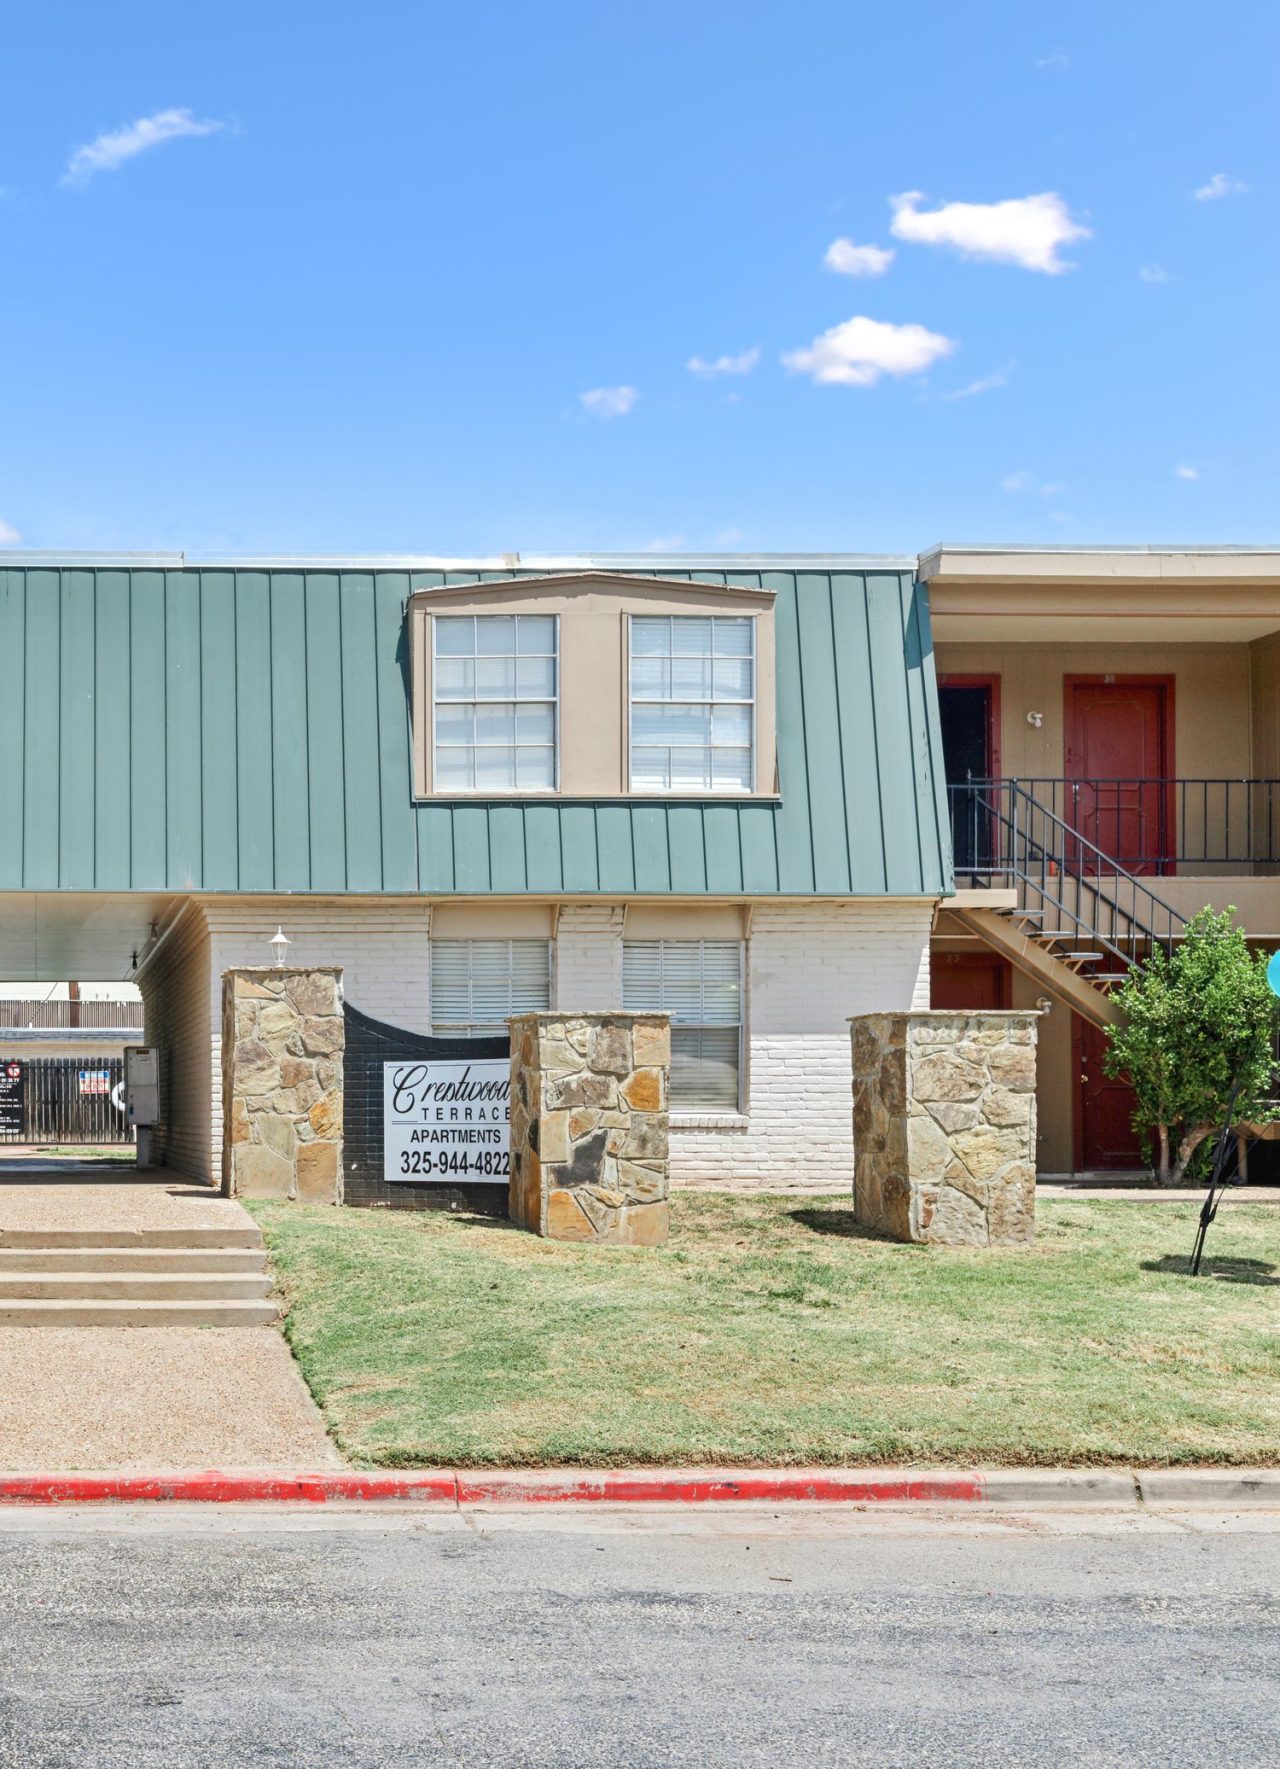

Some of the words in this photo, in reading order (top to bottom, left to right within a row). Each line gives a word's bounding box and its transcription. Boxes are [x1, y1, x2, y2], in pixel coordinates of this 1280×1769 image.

[422, 1107, 510, 1121] TERRACE
[410, 1129, 501, 1144] APARTMENTS
[400, 1151, 510, 1175] 325-944-4822
